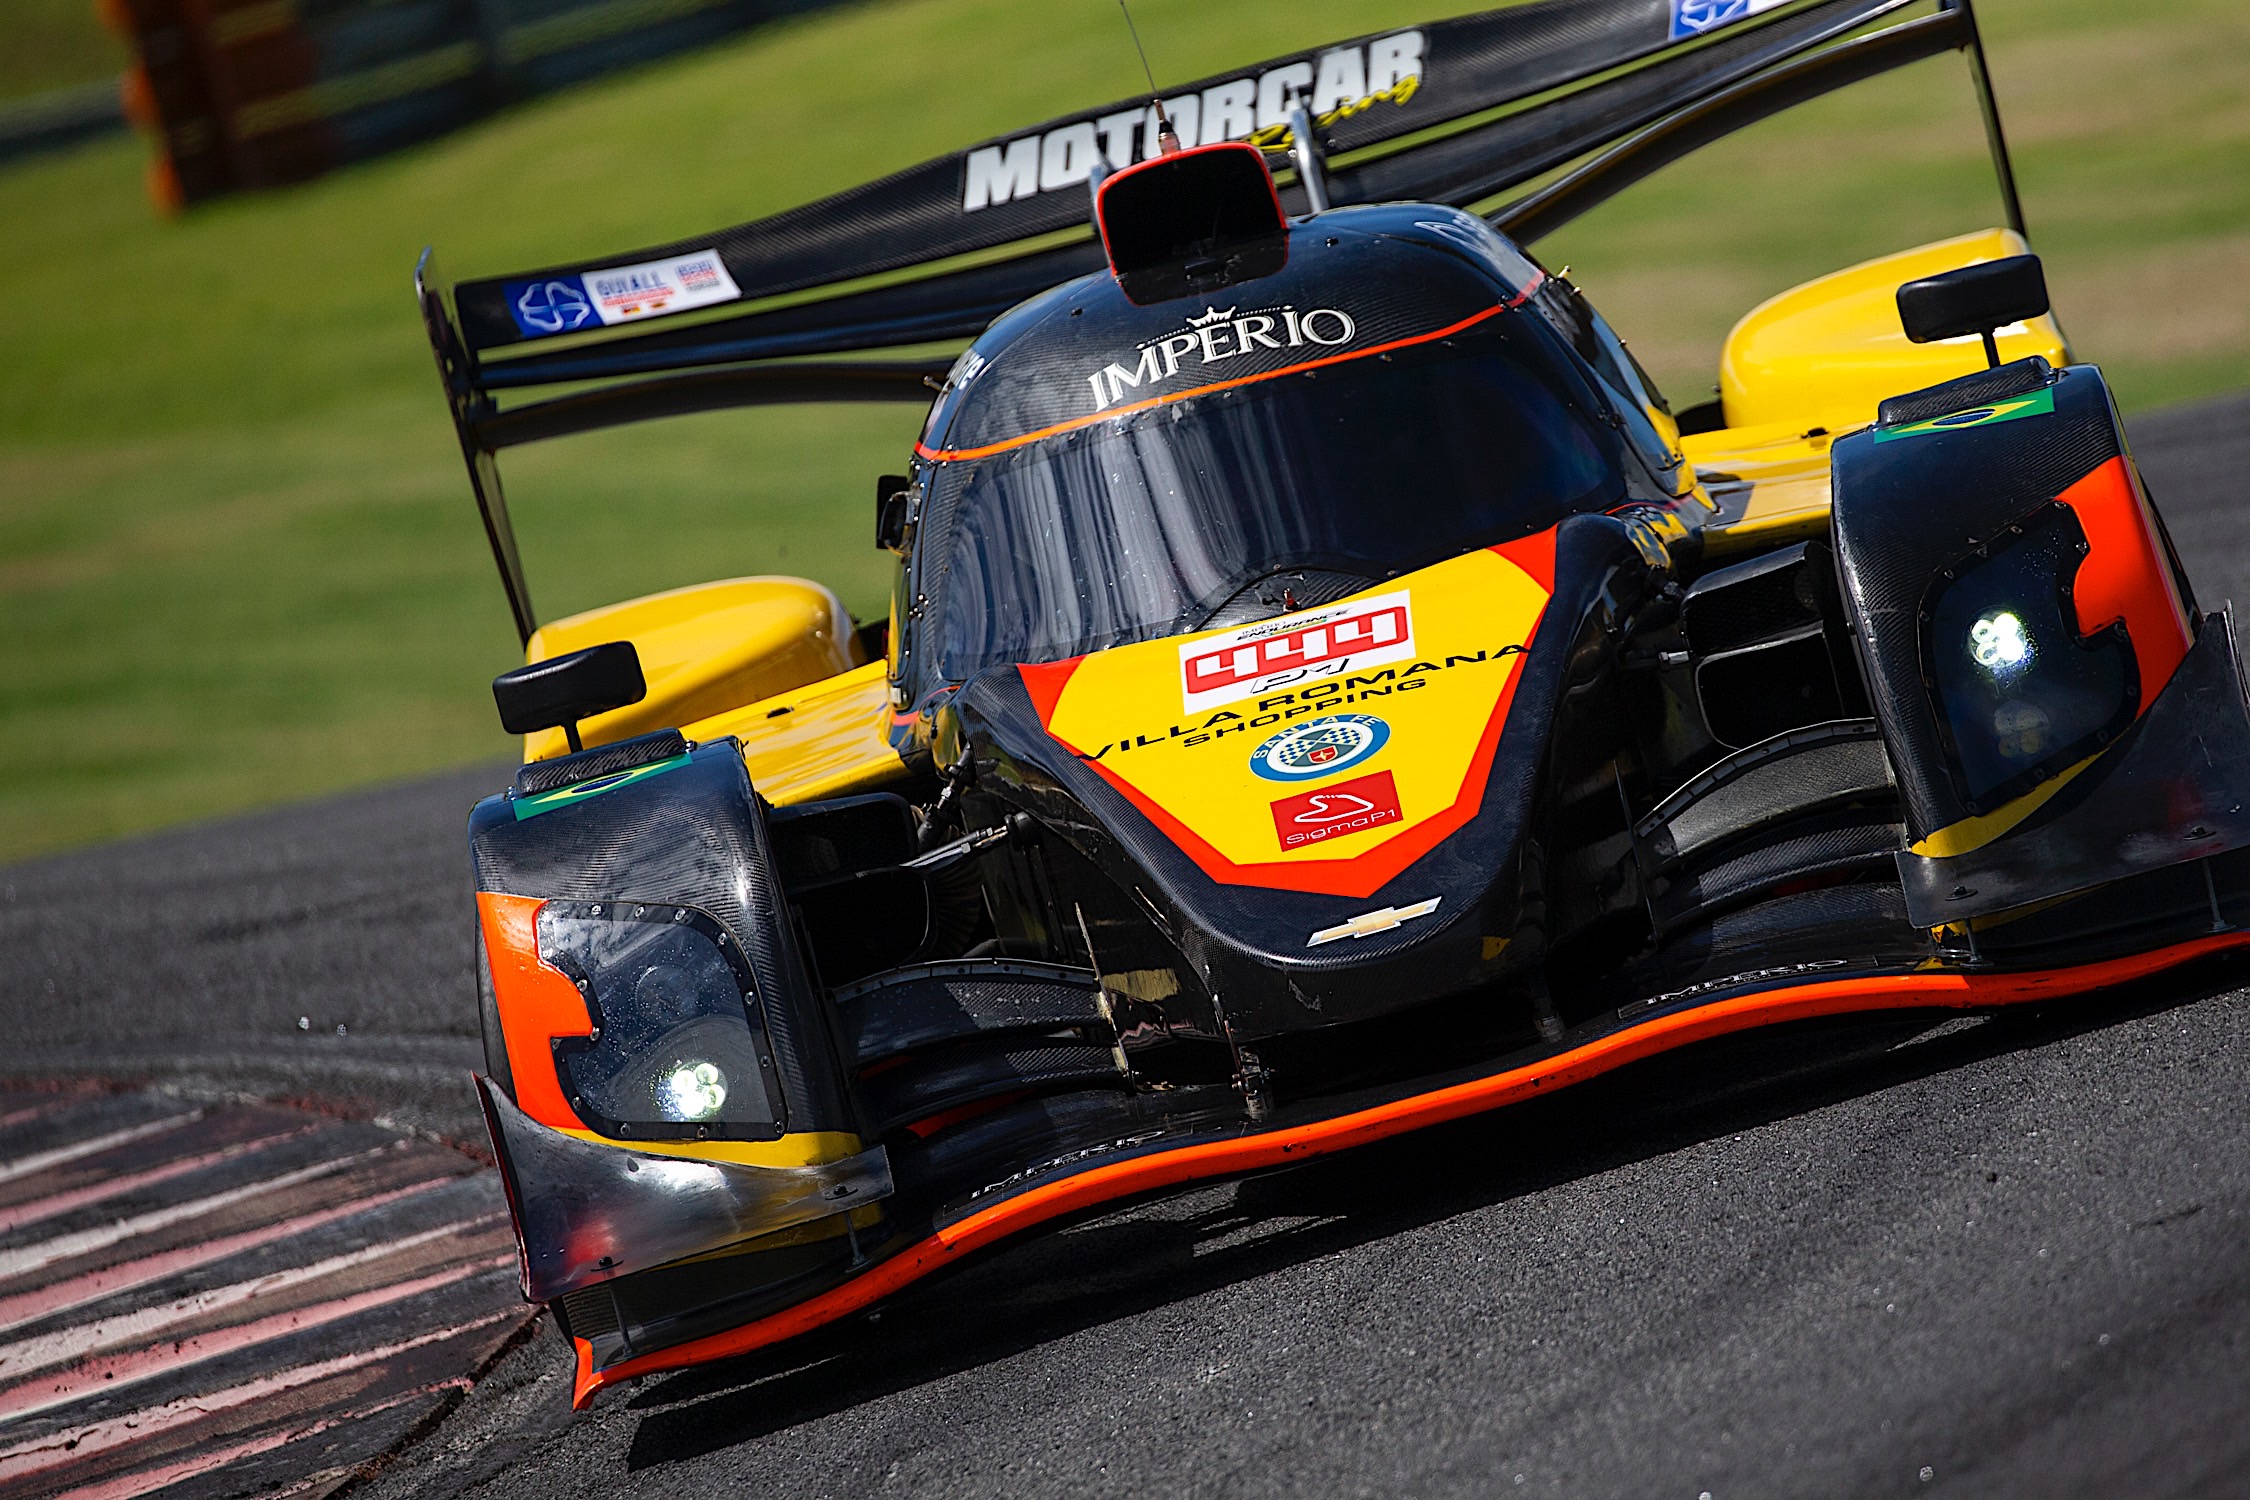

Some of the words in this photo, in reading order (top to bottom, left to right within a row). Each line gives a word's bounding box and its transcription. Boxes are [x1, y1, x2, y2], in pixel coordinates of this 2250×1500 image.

[963, 30, 1425, 213] MOTORCAR
[1195, 611, 1398, 678] 444
[1250, 657, 1350, 694] P1
[1077, 709, 1242, 761] VILLA
[1257, 643, 1531, 713] ROMANA
[1182, 677, 1428, 748] SHOPPING
[1252, 715, 1339, 760] SANTA
[1349, 713, 1383, 728] FE
